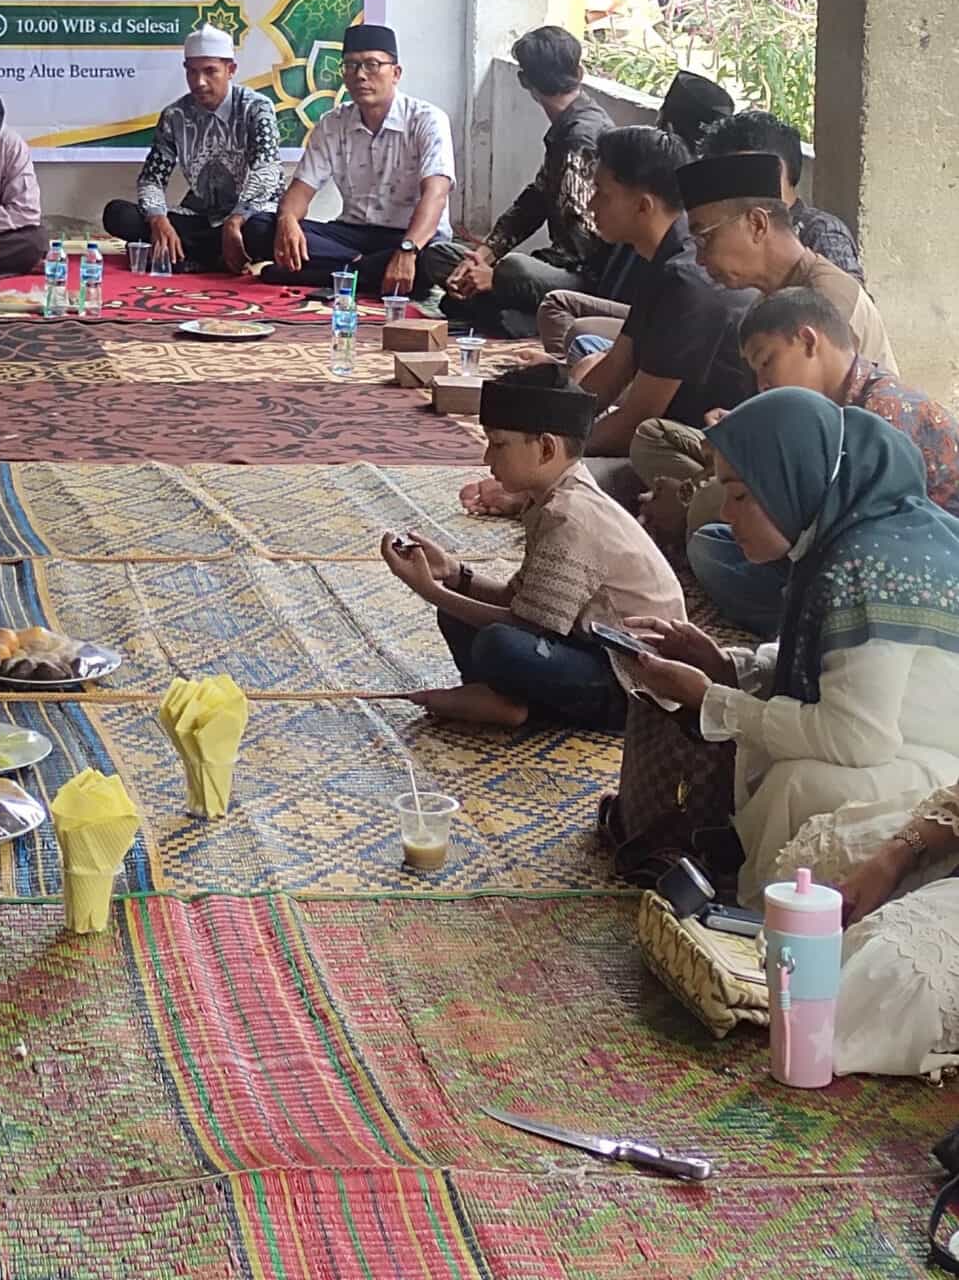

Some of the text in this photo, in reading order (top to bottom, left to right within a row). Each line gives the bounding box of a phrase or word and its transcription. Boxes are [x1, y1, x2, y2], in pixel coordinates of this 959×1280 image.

[16, 19, 58, 34] 10.00
[62, 19, 96, 34] WIB
[99, 19, 122, 34] s.d
[126, 19, 180, 34] Selesai
[30, 65, 66, 79] Alue
[69, 64, 136, 79] Beurawe
